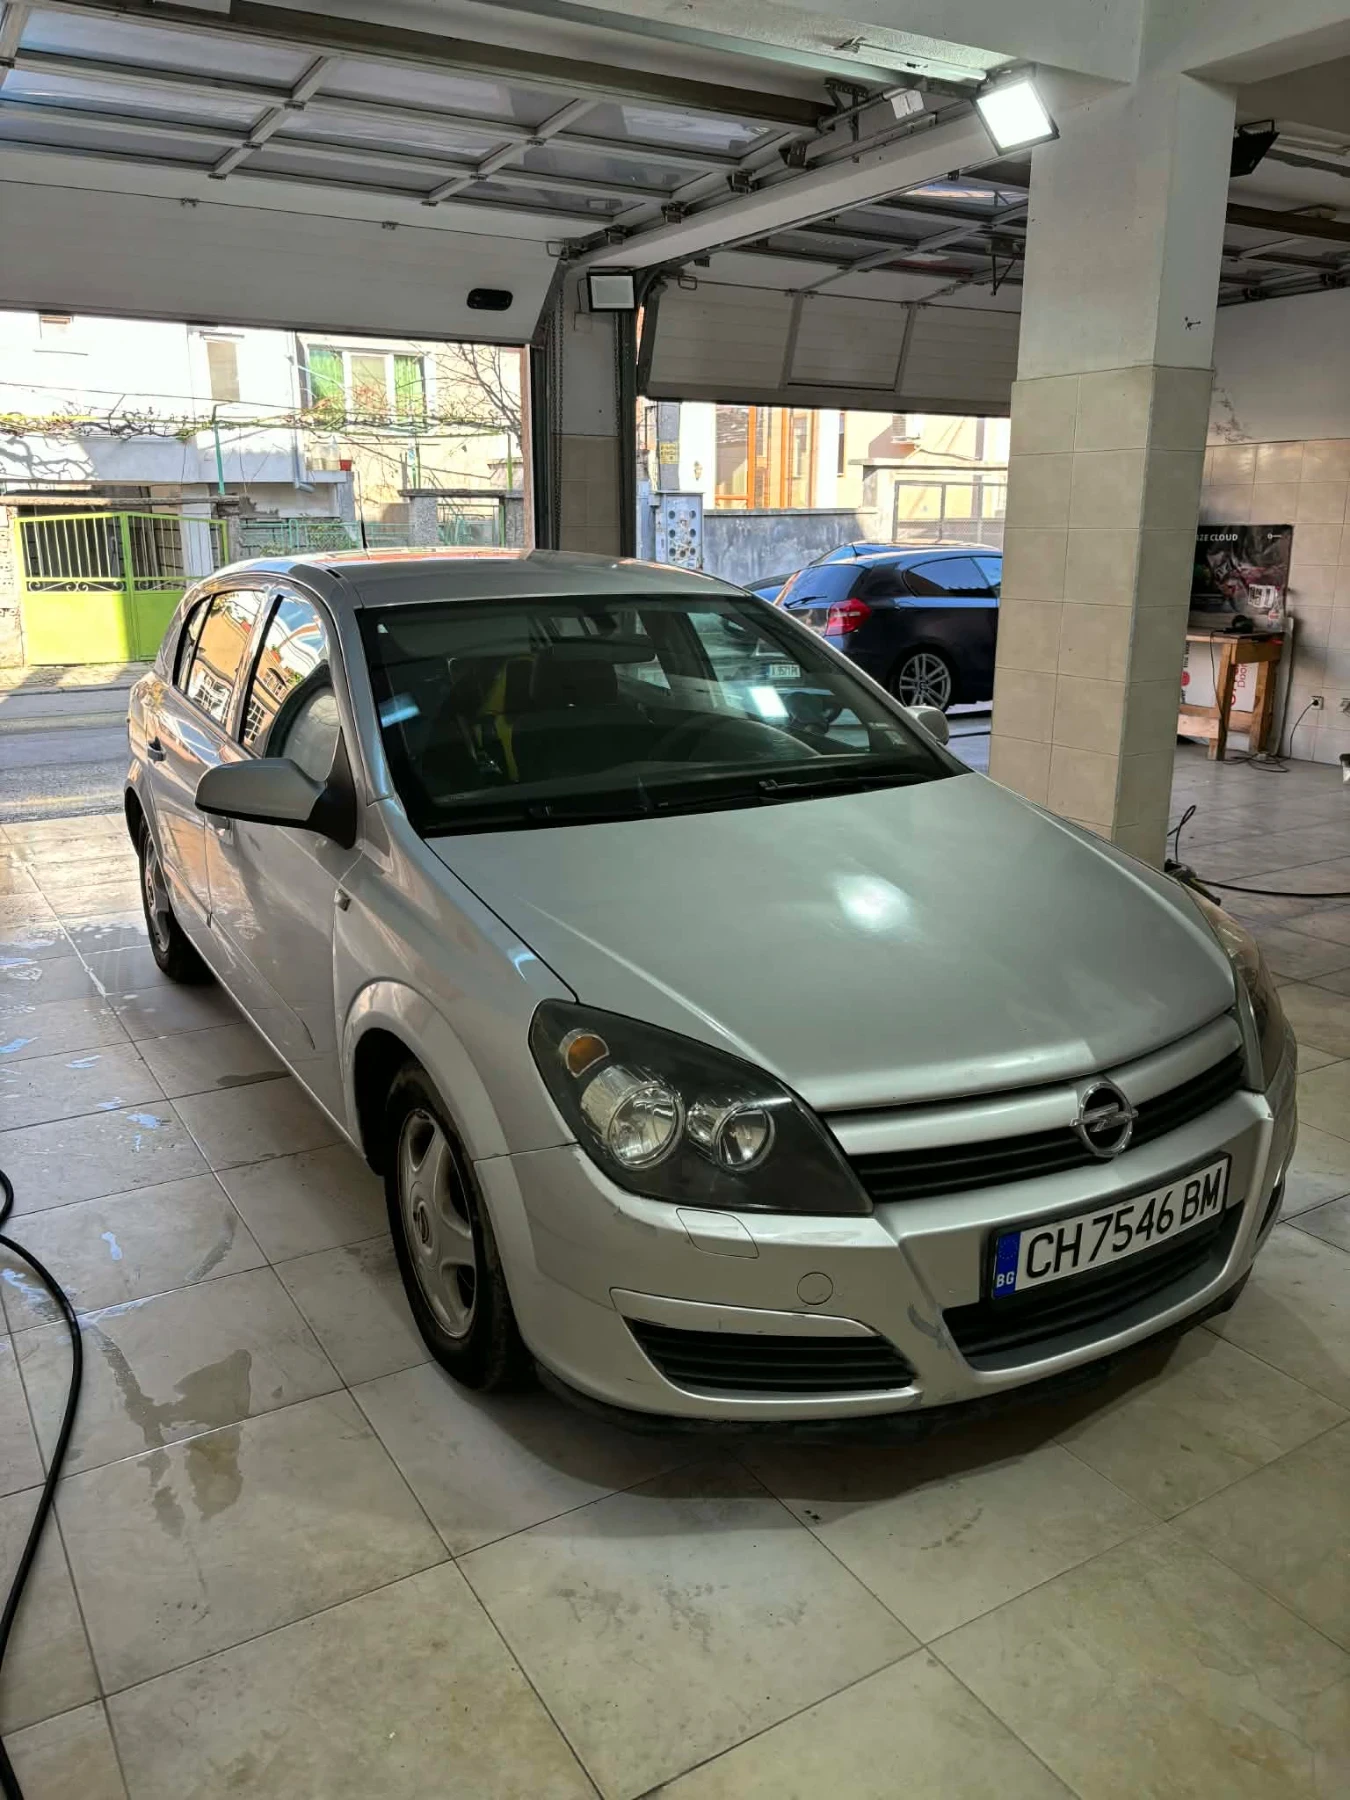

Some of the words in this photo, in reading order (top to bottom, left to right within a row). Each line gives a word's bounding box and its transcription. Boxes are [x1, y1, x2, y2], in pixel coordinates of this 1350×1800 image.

[1210, 533, 1238, 542] CLOUD
[1025, 1221, 1083, 1279] CH
[1088, 1190, 1174, 1262] 7546
[1180, 1167, 1222, 1226] BM
[996, 1271, 1015, 1288] BG
